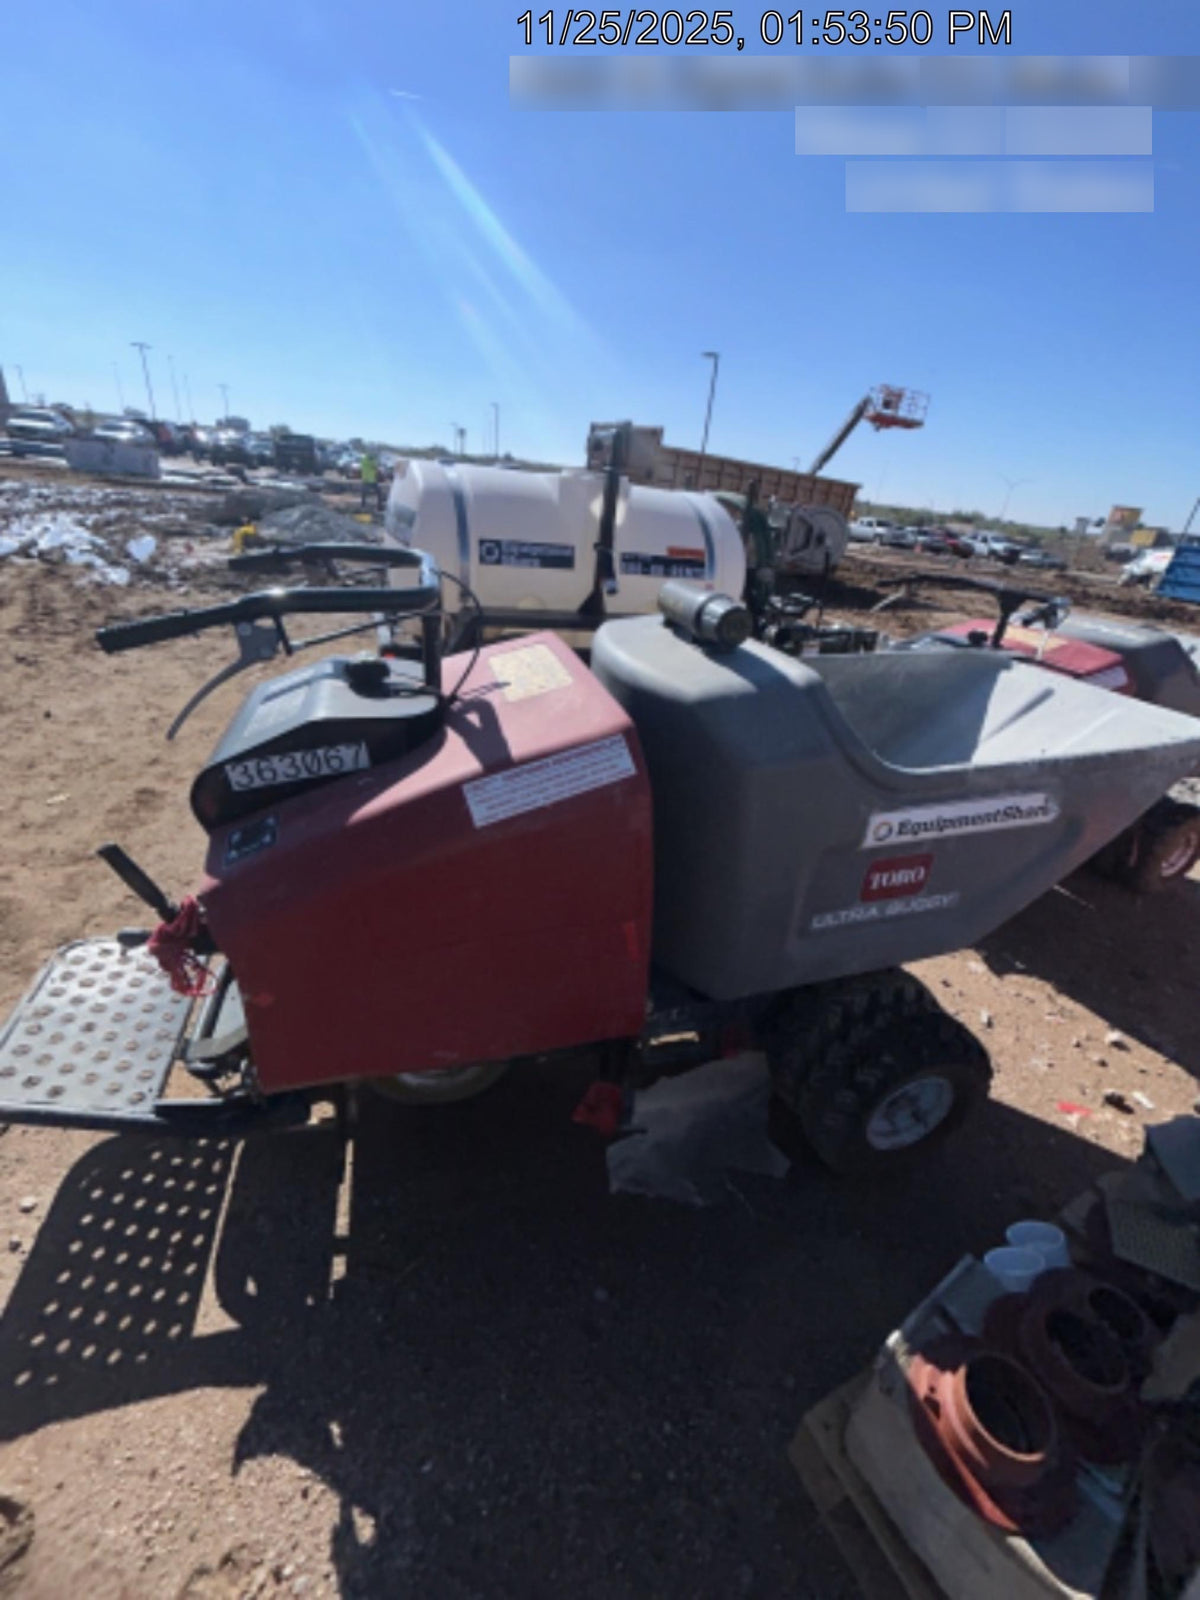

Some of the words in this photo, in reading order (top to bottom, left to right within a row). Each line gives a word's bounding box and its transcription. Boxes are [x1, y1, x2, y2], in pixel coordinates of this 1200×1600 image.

[233, 746, 366, 789] 363067
[869, 867, 926, 891] TORO
[811, 905, 880, 930] ULTRA
